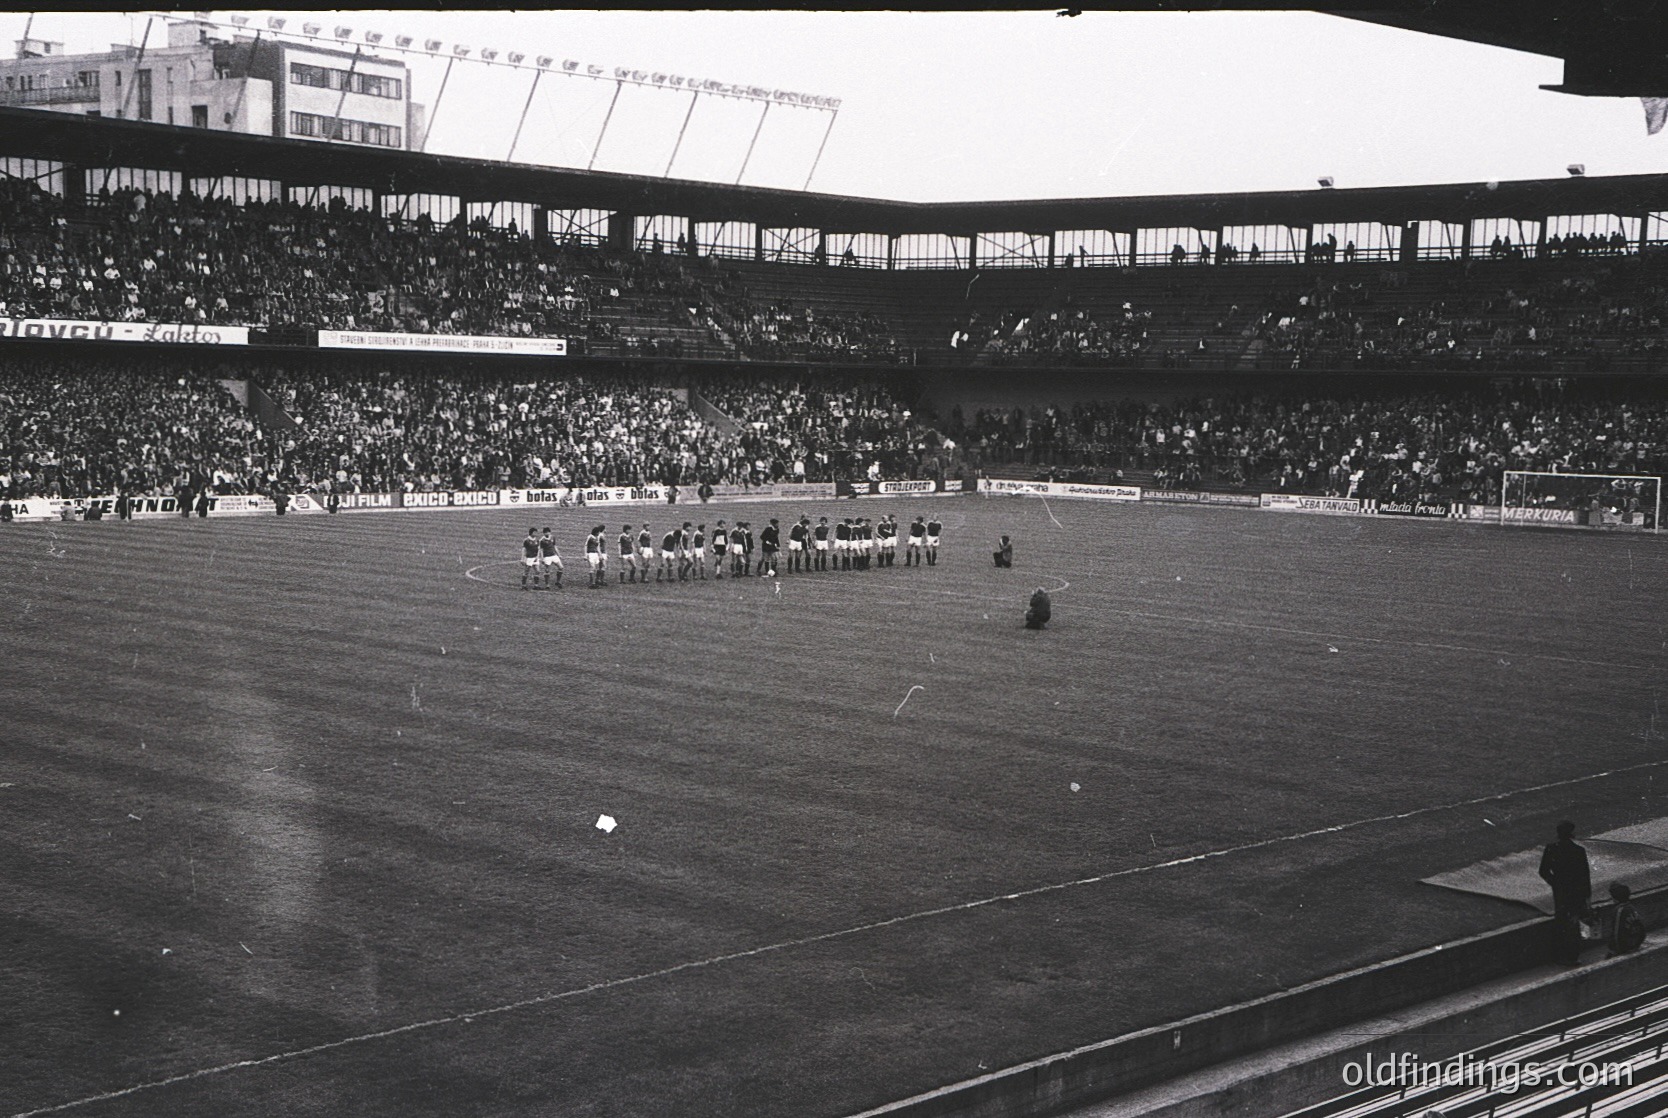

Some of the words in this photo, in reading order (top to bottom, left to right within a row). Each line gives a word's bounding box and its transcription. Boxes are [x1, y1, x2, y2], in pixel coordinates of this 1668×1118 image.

[358, 494, 391, 506] FILM
[526, 490, 557, 503] botas
[587, 489, 609, 501] otas
[630, 488, 659, 499] botas
[1502, 506, 1575, 522] MERKURIA
